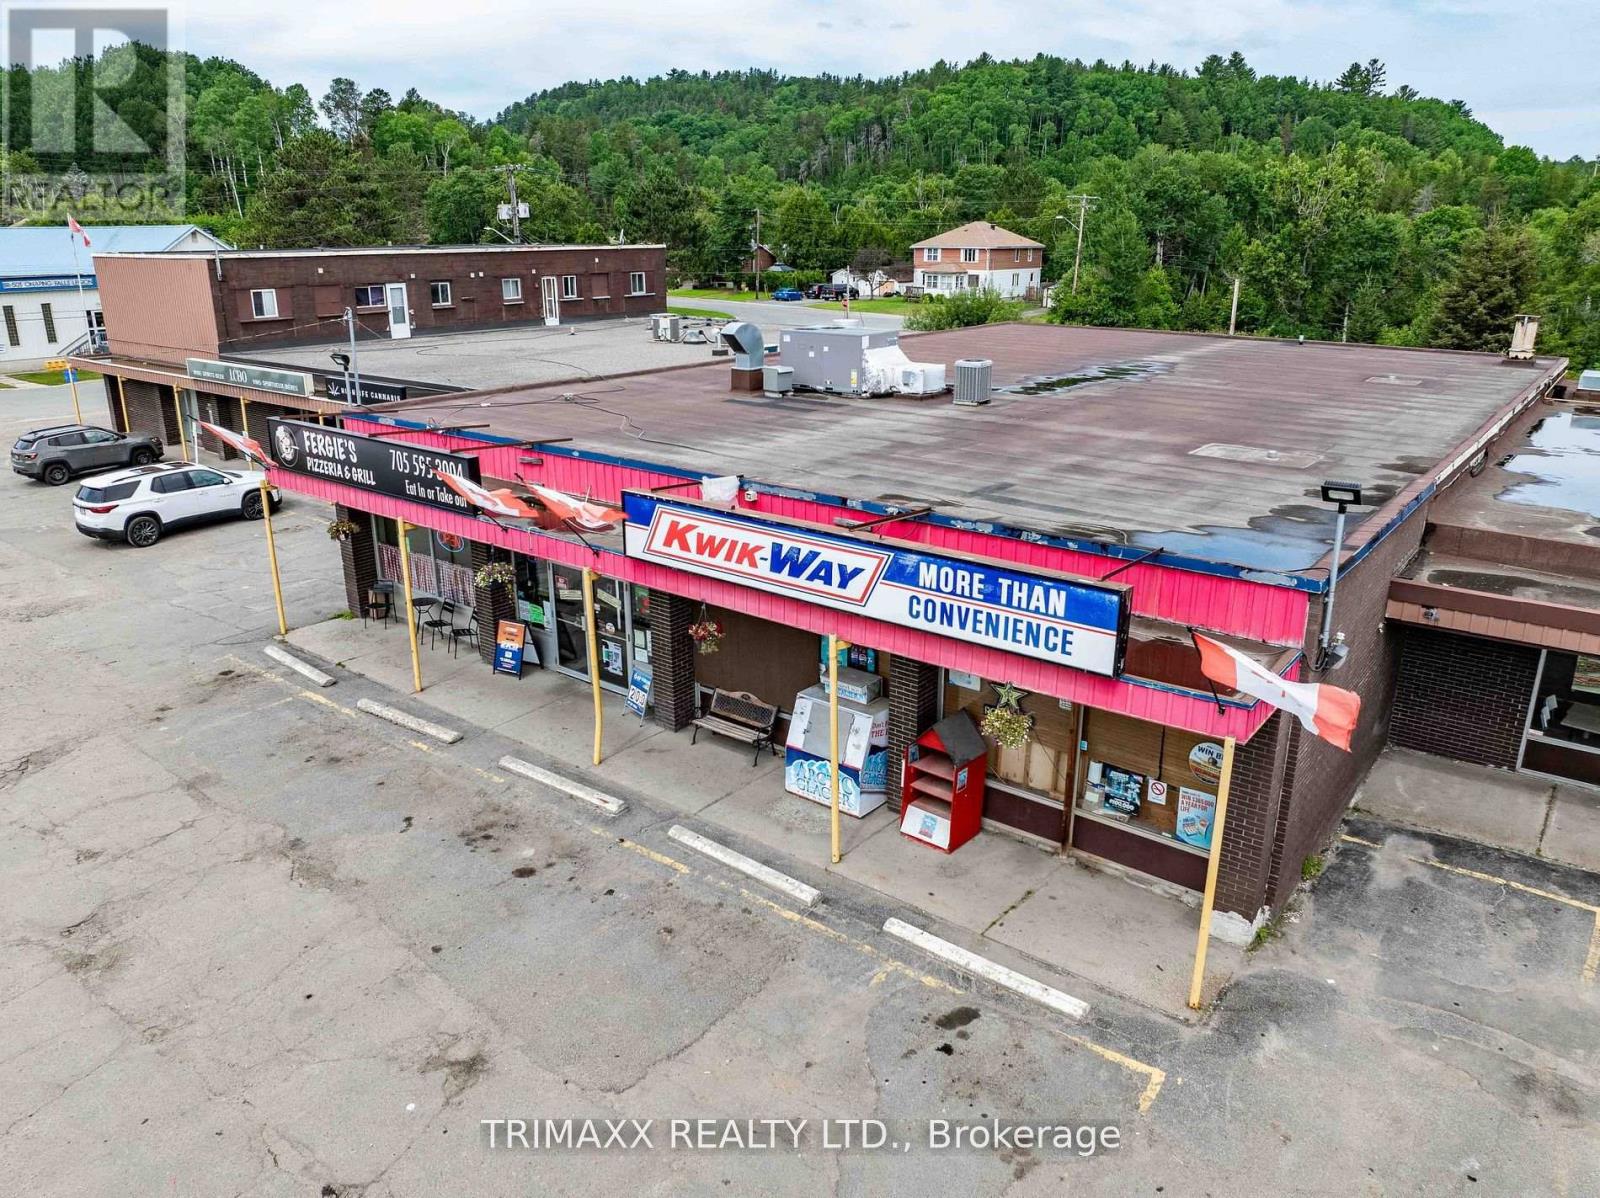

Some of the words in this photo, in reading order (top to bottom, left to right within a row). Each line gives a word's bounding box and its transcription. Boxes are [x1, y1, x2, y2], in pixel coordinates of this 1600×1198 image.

[229, 367, 247, 383] LCBO
[370, 391, 401, 402] CANNABIS
[302, 430, 358, 463] FERGIE'S
[306, 456, 344, 478] PIZZERIA
[344, 465, 351, 480] &
[351, 467, 377, 486] GRILL
[389, 449, 410, 474] 705
[412, 454, 433, 479] 595
[405, 480, 417, 496] Eat
[417, 482, 426, 498] In
[426, 488, 436, 501] or
[435, 486, 454, 504] Take
[918, 561, 985, 600] MORE
[998, 577, 1067, 618] THAN
[908, 594, 1075, 656] CONVENIENCE
[1197, 745, 1215, 757] WIN
